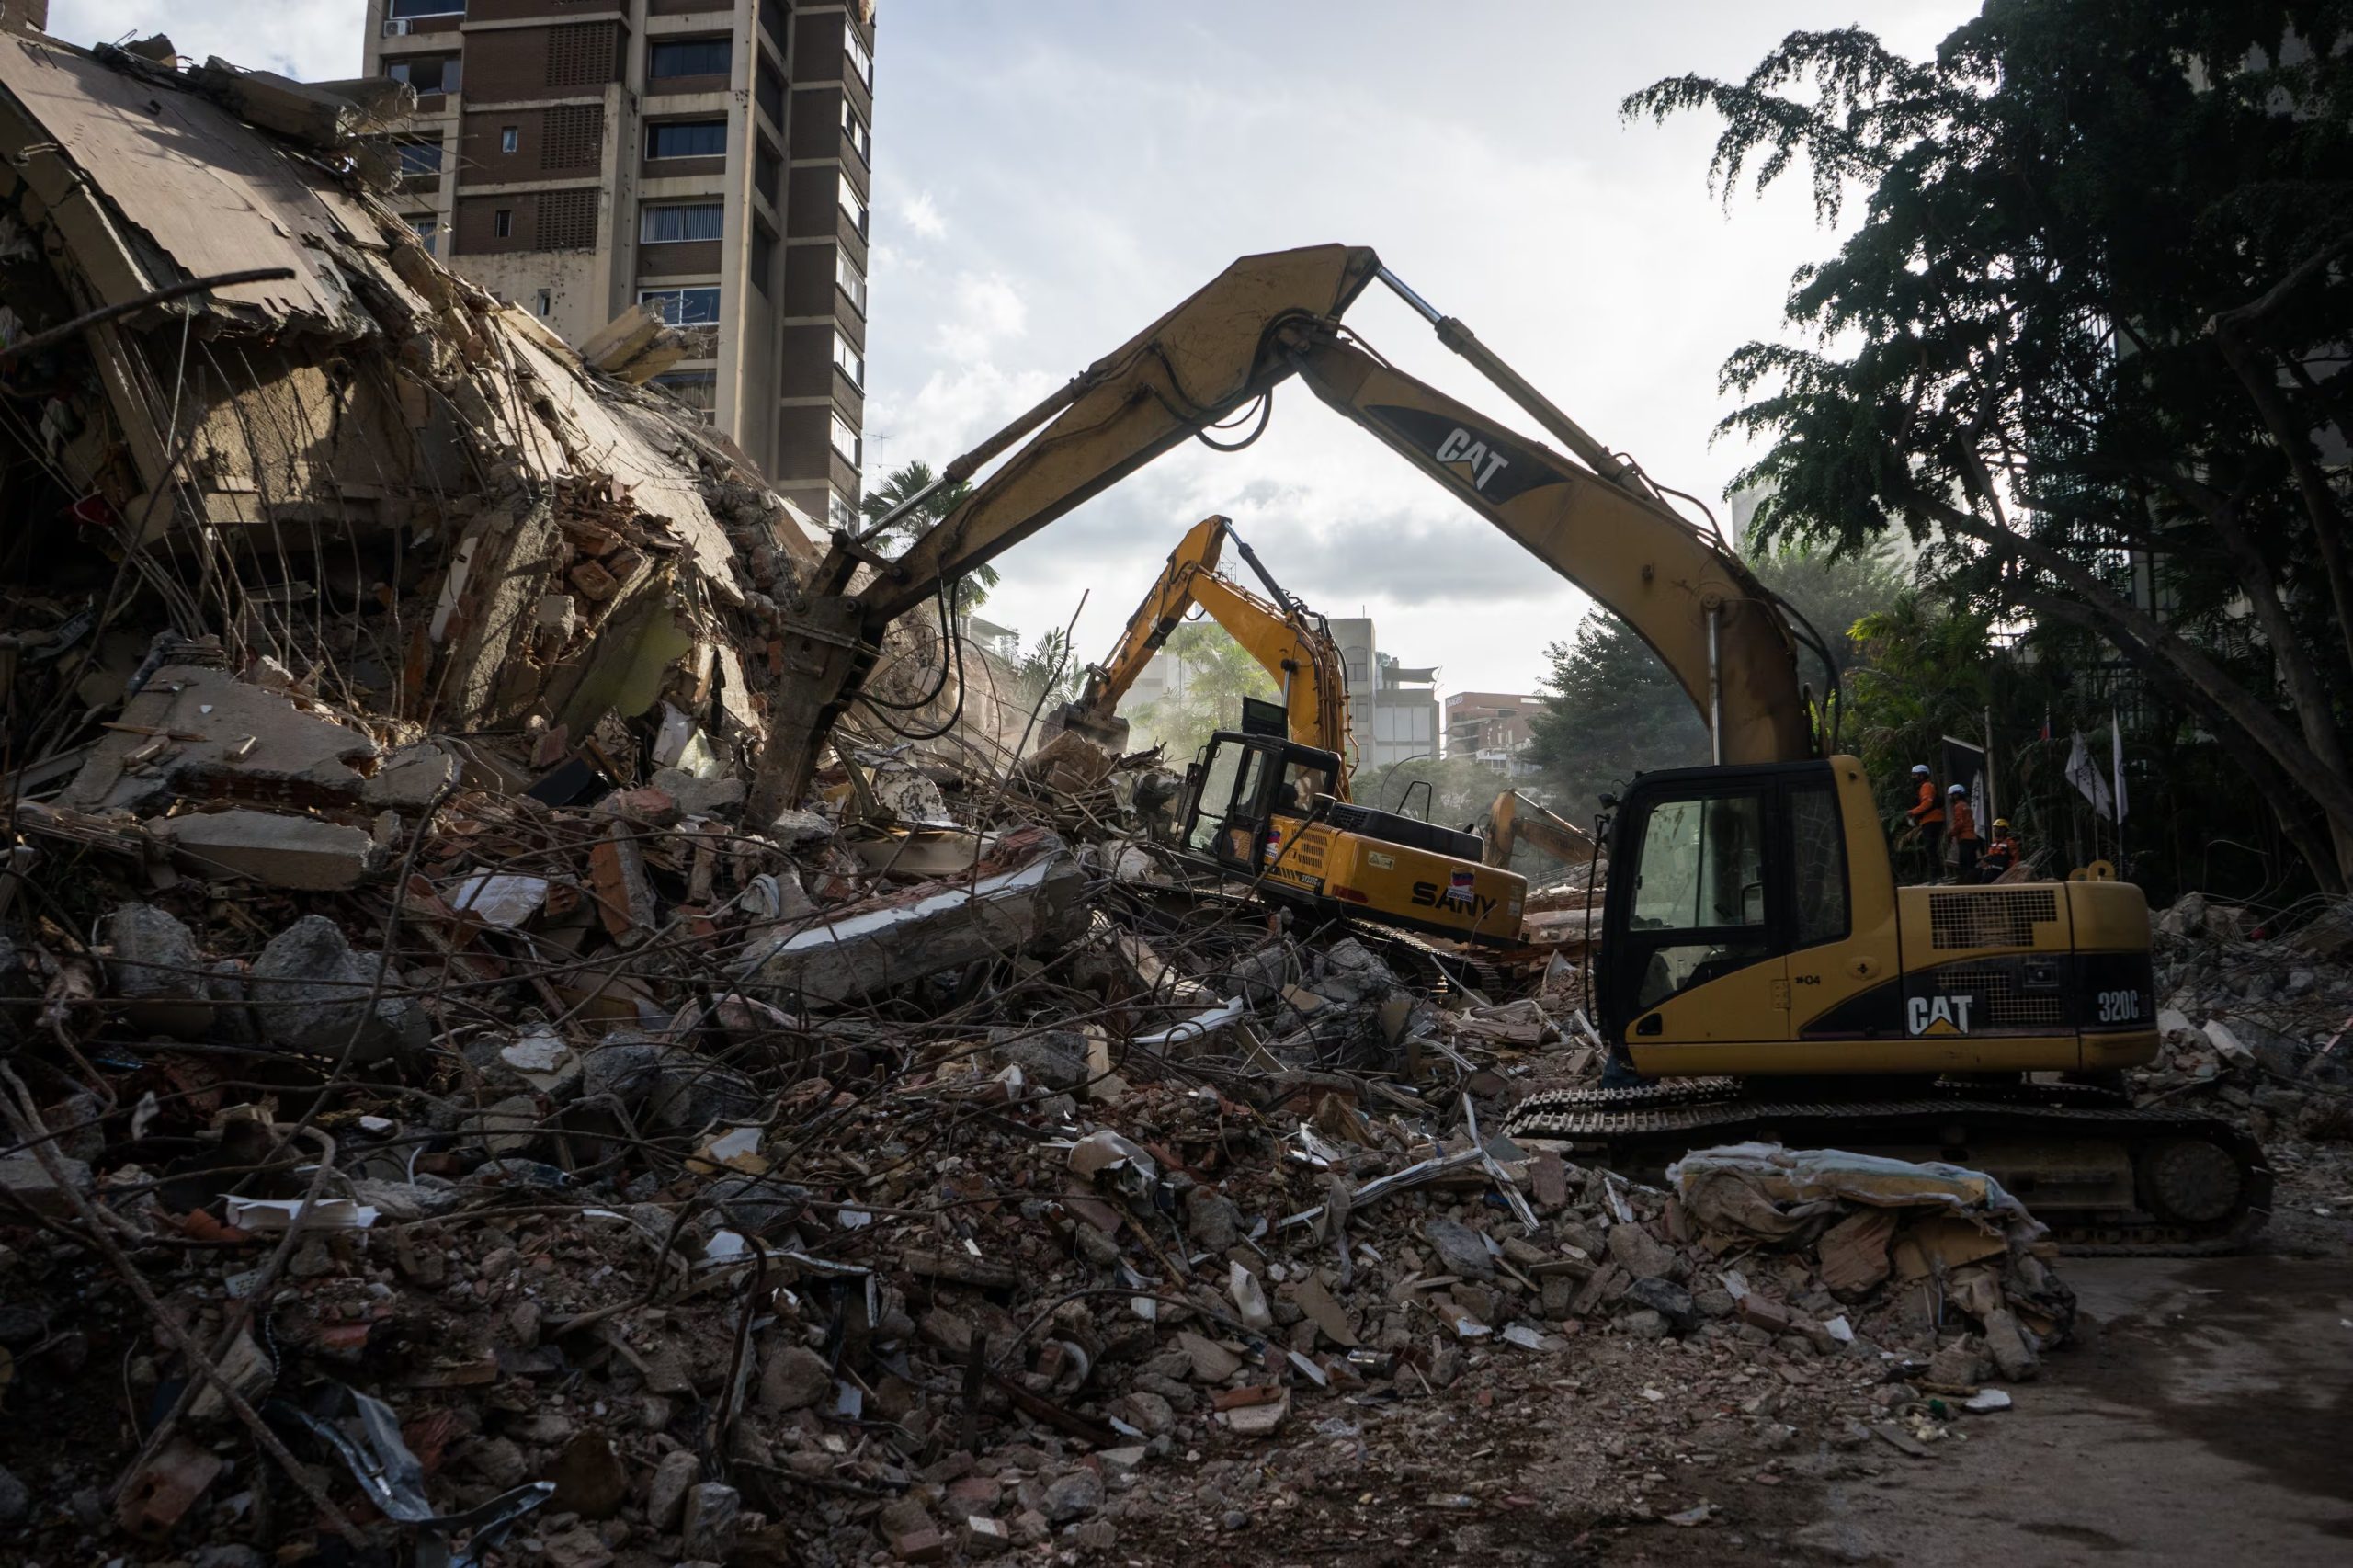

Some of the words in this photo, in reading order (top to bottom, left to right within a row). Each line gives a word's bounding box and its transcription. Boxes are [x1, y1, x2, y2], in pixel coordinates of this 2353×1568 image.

[1435, 427, 1509, 491] CAT
[1412, 881, 1496, 919] SANY
[1794, 974, 1821, 985] #04
[1907, 995, 1973, 1036] CAT
[2098, 989, 2140, 1023] 320C
